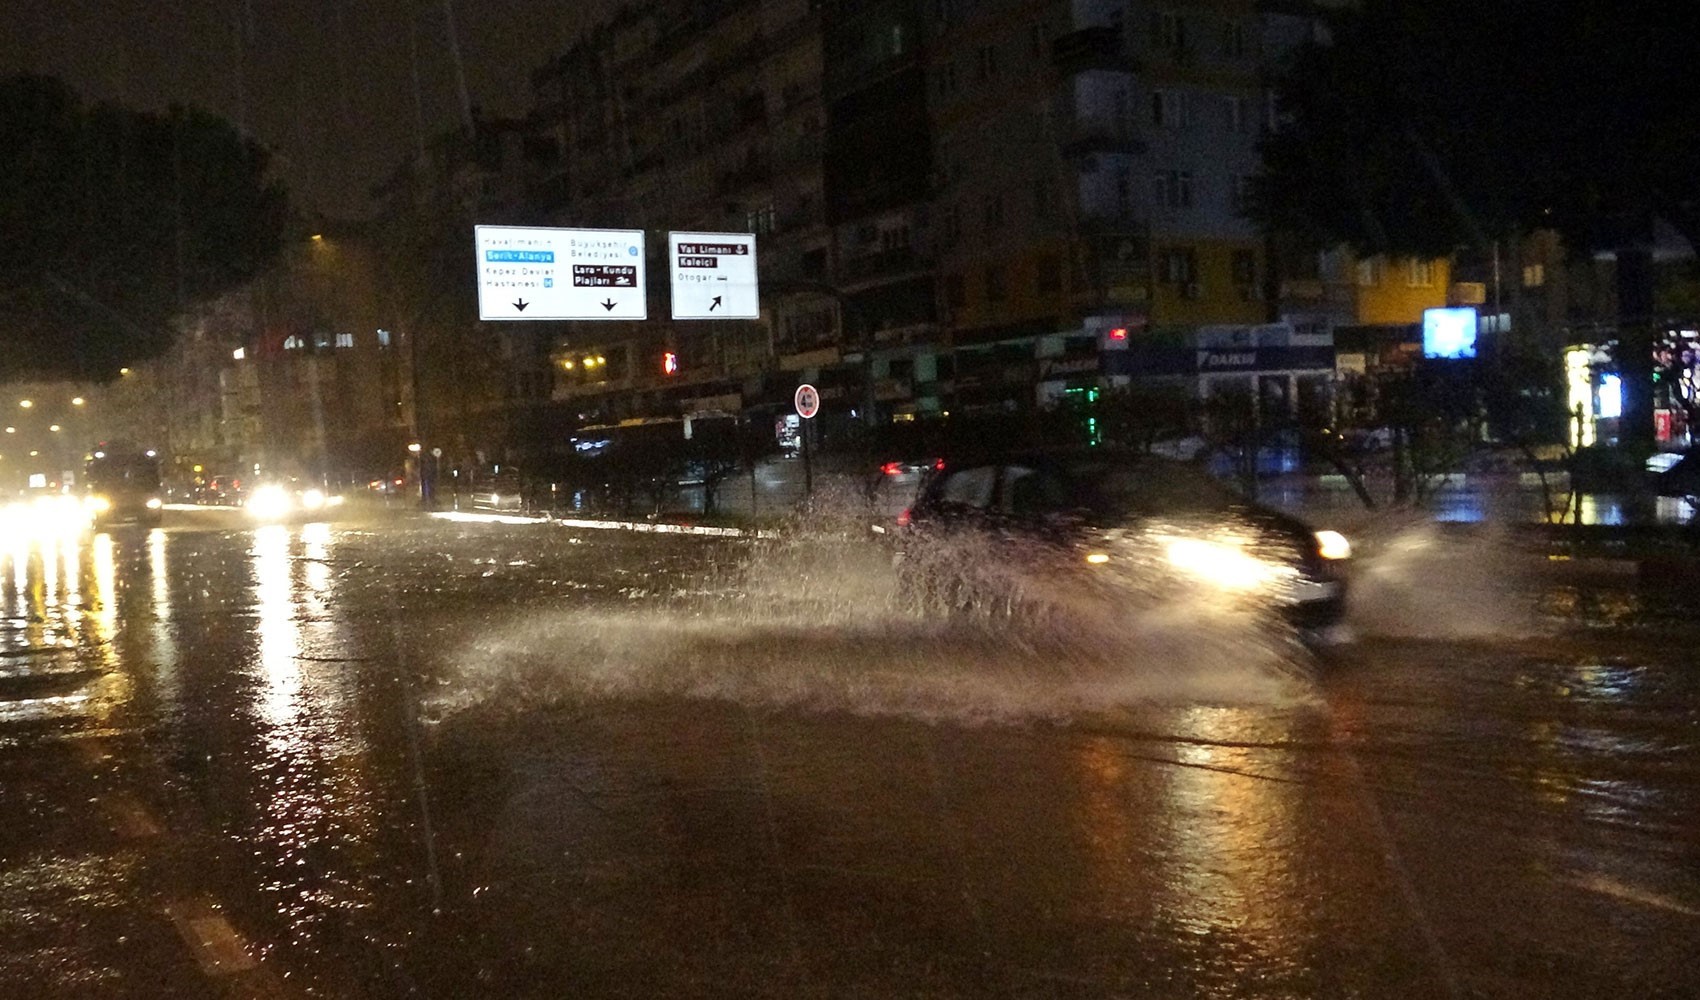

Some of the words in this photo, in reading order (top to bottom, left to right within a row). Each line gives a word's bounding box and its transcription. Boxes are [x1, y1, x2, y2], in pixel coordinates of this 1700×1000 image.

[679, 245, 697, 254] Yat
[486, 267, 516, 276] Kepez
[574, 266, 595, 274] Lara
[603, 266, 634, 275] Kundu
[678, 273, 712, 283] Otogar
